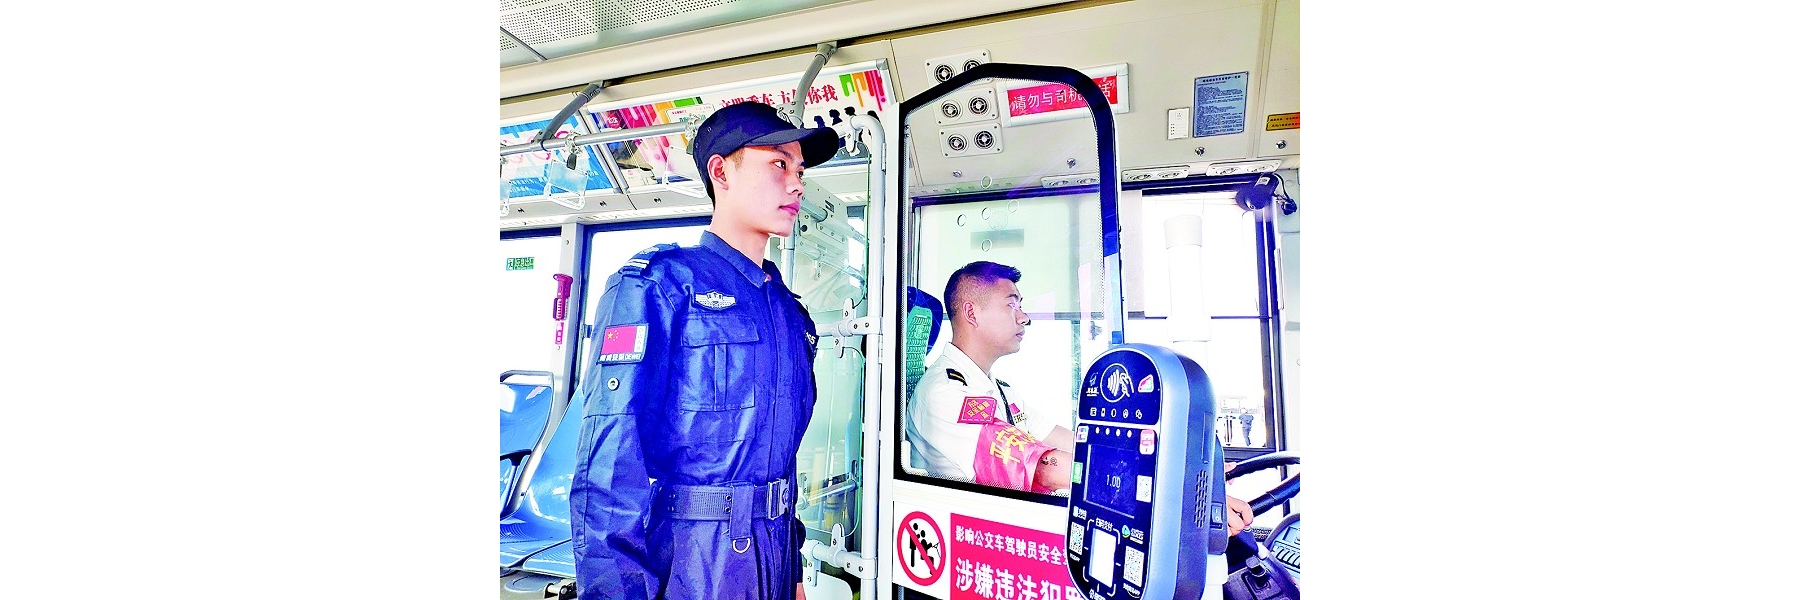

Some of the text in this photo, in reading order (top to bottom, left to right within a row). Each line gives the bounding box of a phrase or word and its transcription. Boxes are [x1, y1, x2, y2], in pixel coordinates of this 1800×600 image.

[1012, 82, 1111, 110] 请勿与司机话
[1106, 474, 1121, 489] 1.00
